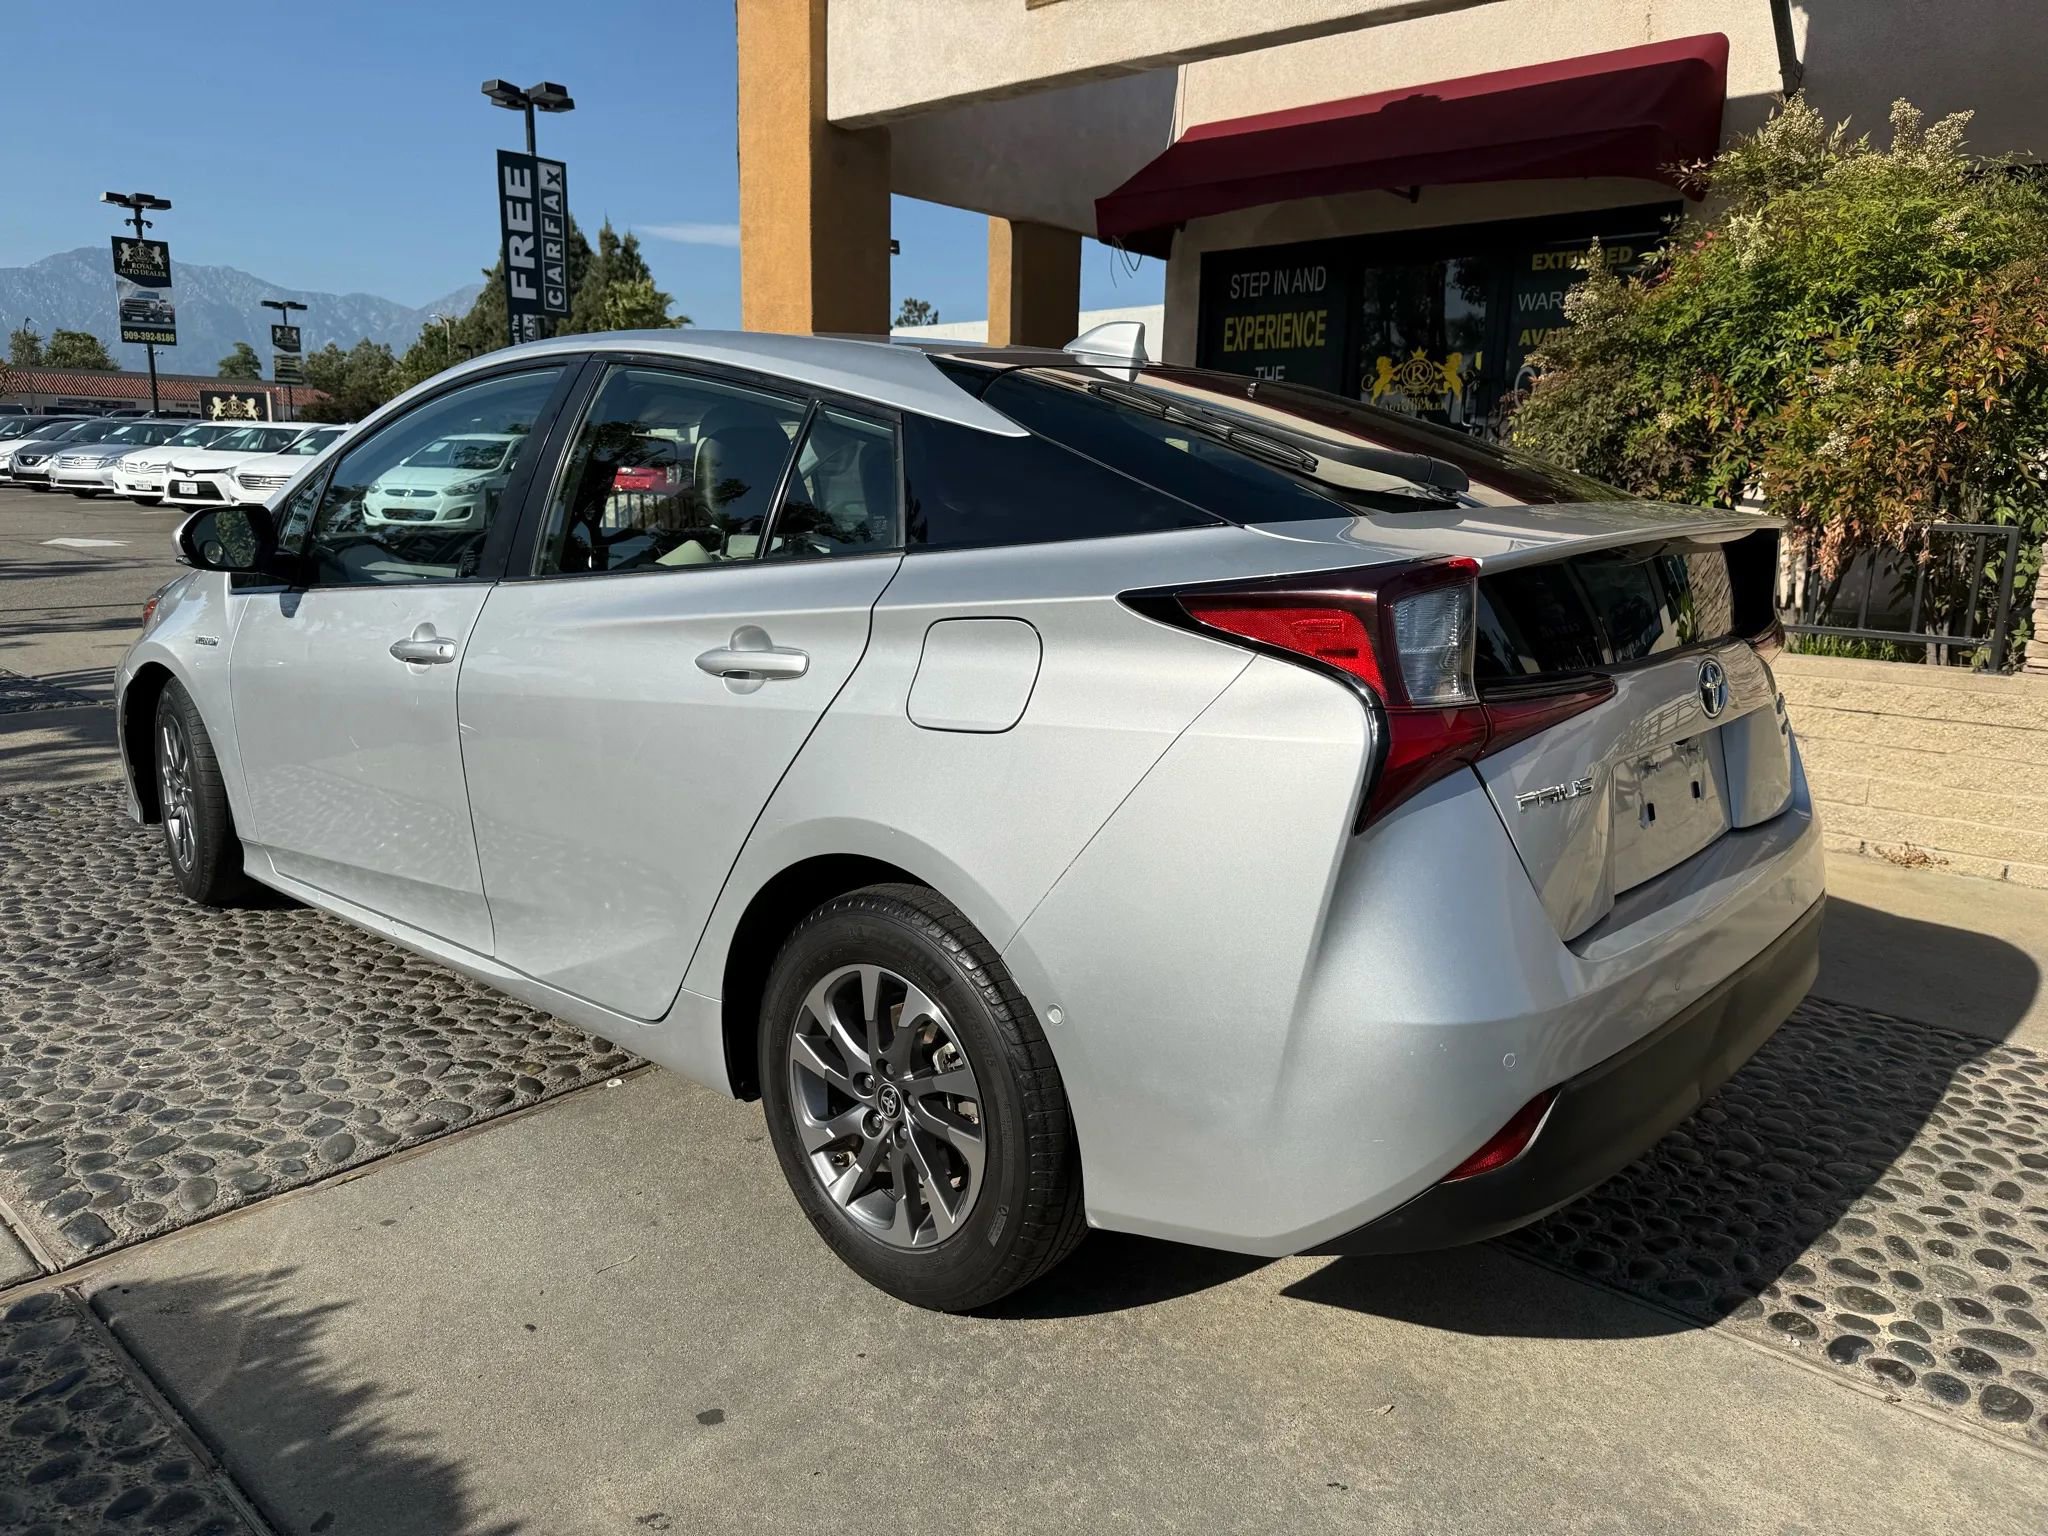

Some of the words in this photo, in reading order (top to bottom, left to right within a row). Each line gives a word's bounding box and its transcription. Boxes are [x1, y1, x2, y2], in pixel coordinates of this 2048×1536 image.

[503, 166, 537, 300] FREE
[543, 167, 564, 306] CARFAX
[119, 267, 140, 275] AUTO
[140, 269, 167, 278] DEALER
[131, 262, 153, 270] ROYAL
[1532, 246, 1633, 270] EXTEED
[1230, 271, 1270, 299] STEP
[1274, 269, 1289, 296] IN
[1292, 265, 1327, 293] AND
[123, 330, 175, 343] 909-392-8186
[1223, 309, 1328, 352] EXPERIENCE
[1515, 777, 1593, 812] PRIUS
